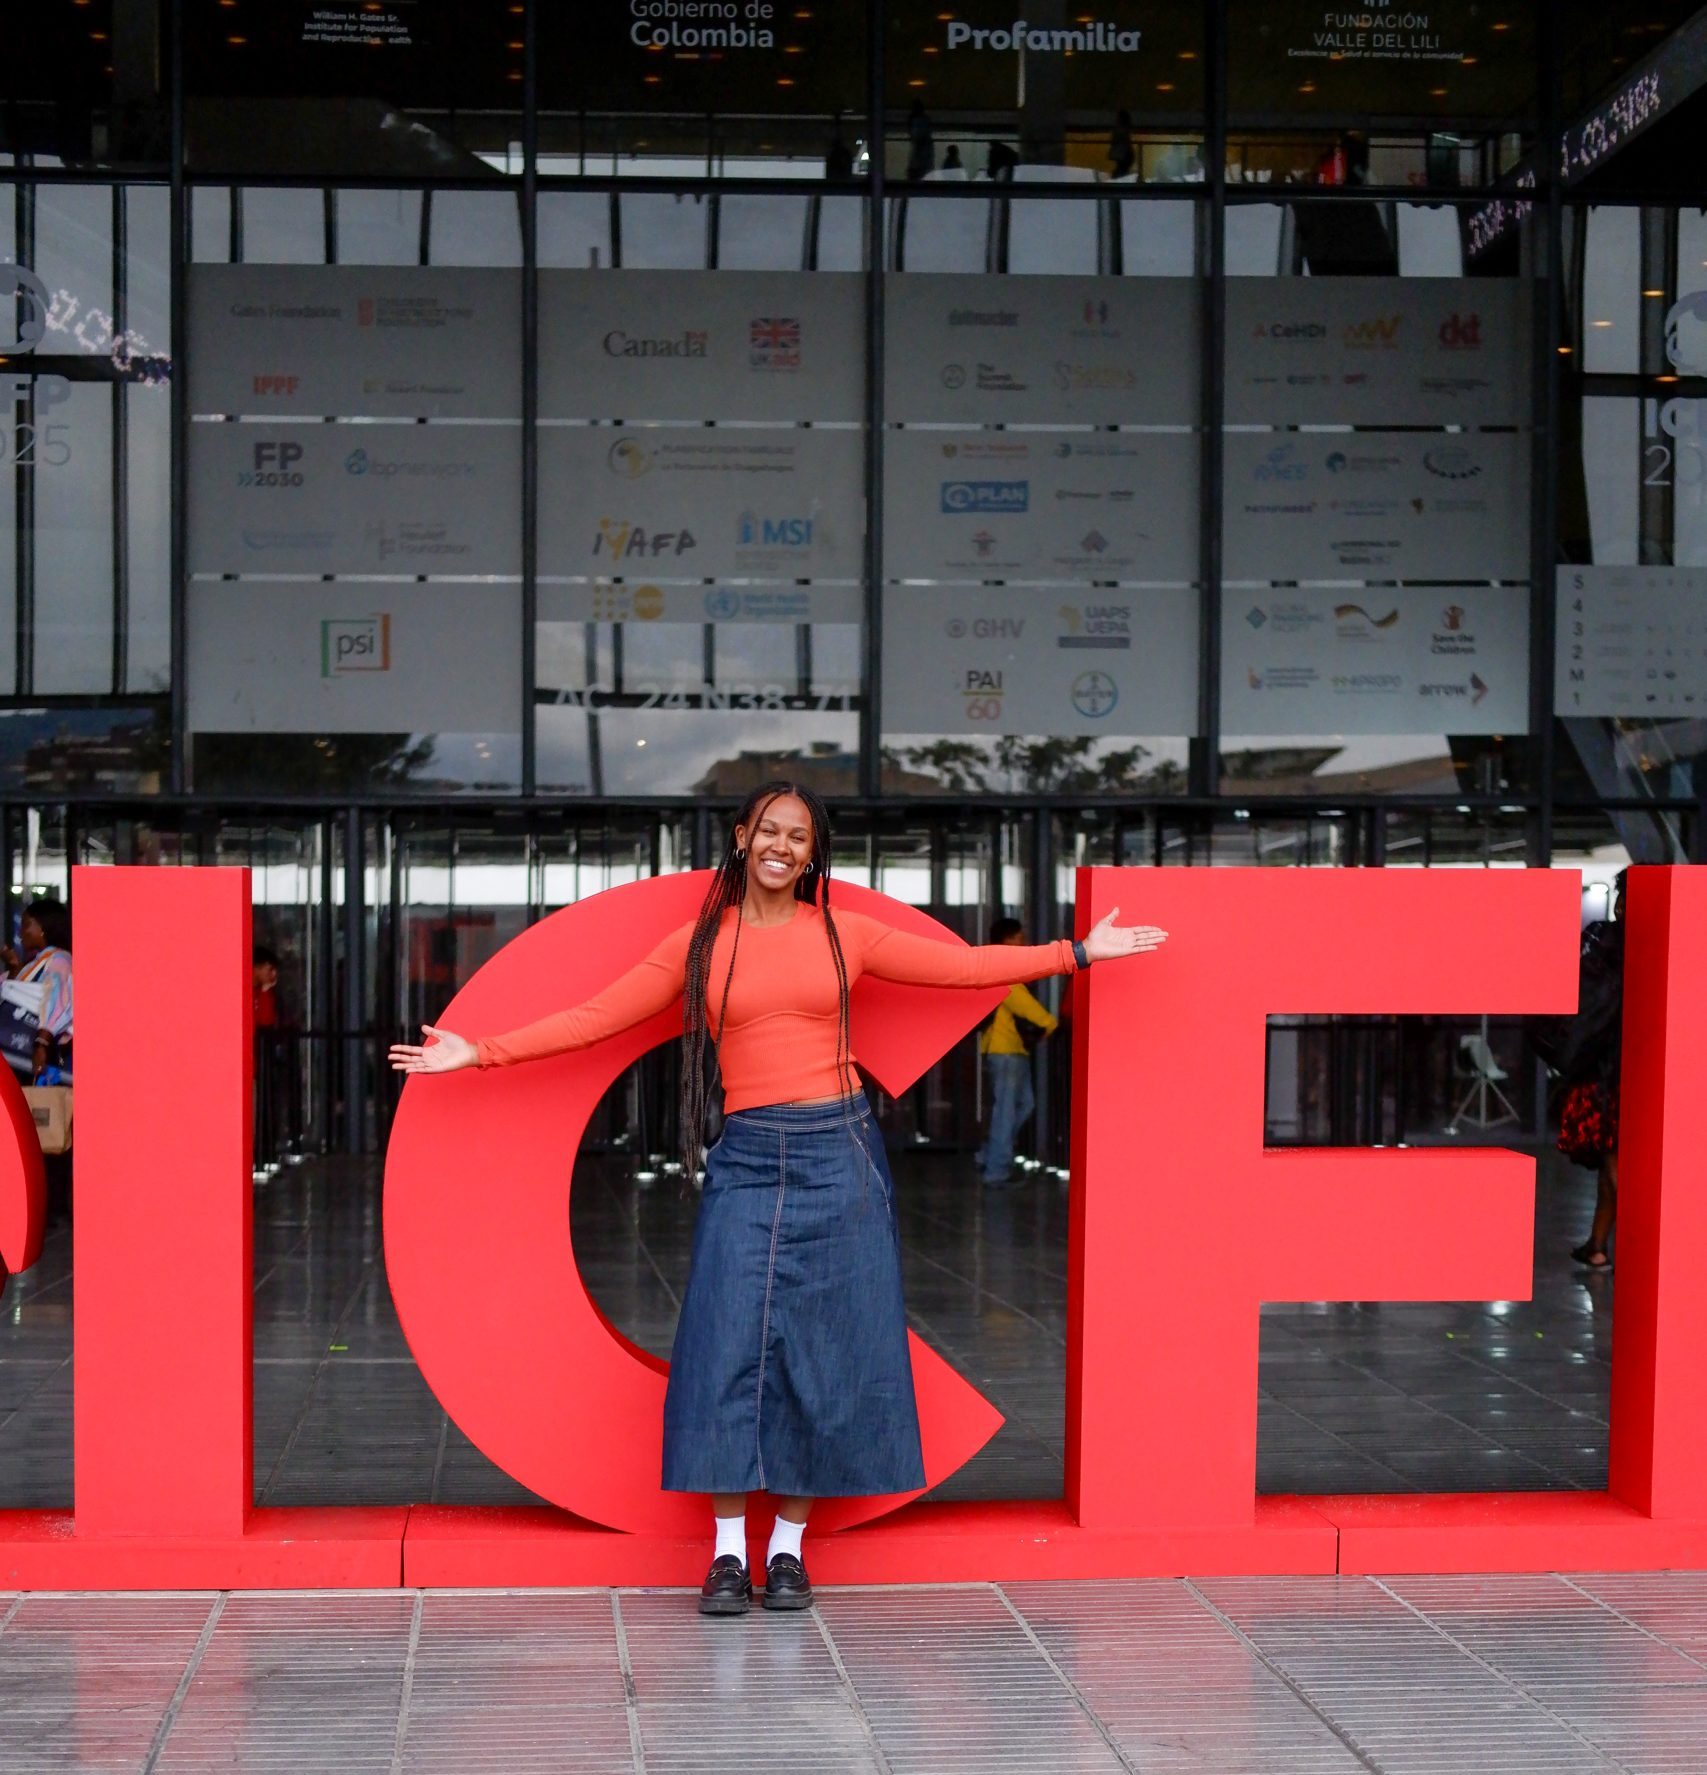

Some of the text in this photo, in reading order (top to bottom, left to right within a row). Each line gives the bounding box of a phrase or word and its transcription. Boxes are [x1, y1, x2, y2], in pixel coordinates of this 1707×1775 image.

[313, 11, 346, 20] William
[360, 13, 385, 21] Gates
[388, 14, 399, 22] Sr.
[630, 0, 774, 18] Gobierno de
[304, 22, 408, 33] Institute for Population
[1324, 12, 1429, 29] FUNDACIÓN
[302, 33, 319, 41] and
[630, 21, 774, 47] Colombia
[947, 21, 1142, 52] Profamilia
[1313, 33, 1439, 48] VALLE DEL LILI
[603, 330, 707, 357] Canada
[253, 375, 298, 395] IPPF
[0, 424, 71, 466] 25
[253, 442, 304, 470] FP
[255, 472, 304, 487] 2030
[763, 519, 812, 545] MSI
[1085, 606, 1131, 619] UAPS
[1572, 599, 1582, 613] 4
[973, 618, 1026, 638] GHV
[1085, 621, 1131, 634] UEPA
[1573, 621, 1583, 636] 3
[337, 628, 374, 662] psi
[1573, 644, 1582, 660] 2
[966, 670, 1003, 689] PAI
[637, 682, 690, 711] 24
[966, 698, 1002, 721] 60
[72, 863, 1707, 1536] ICF
